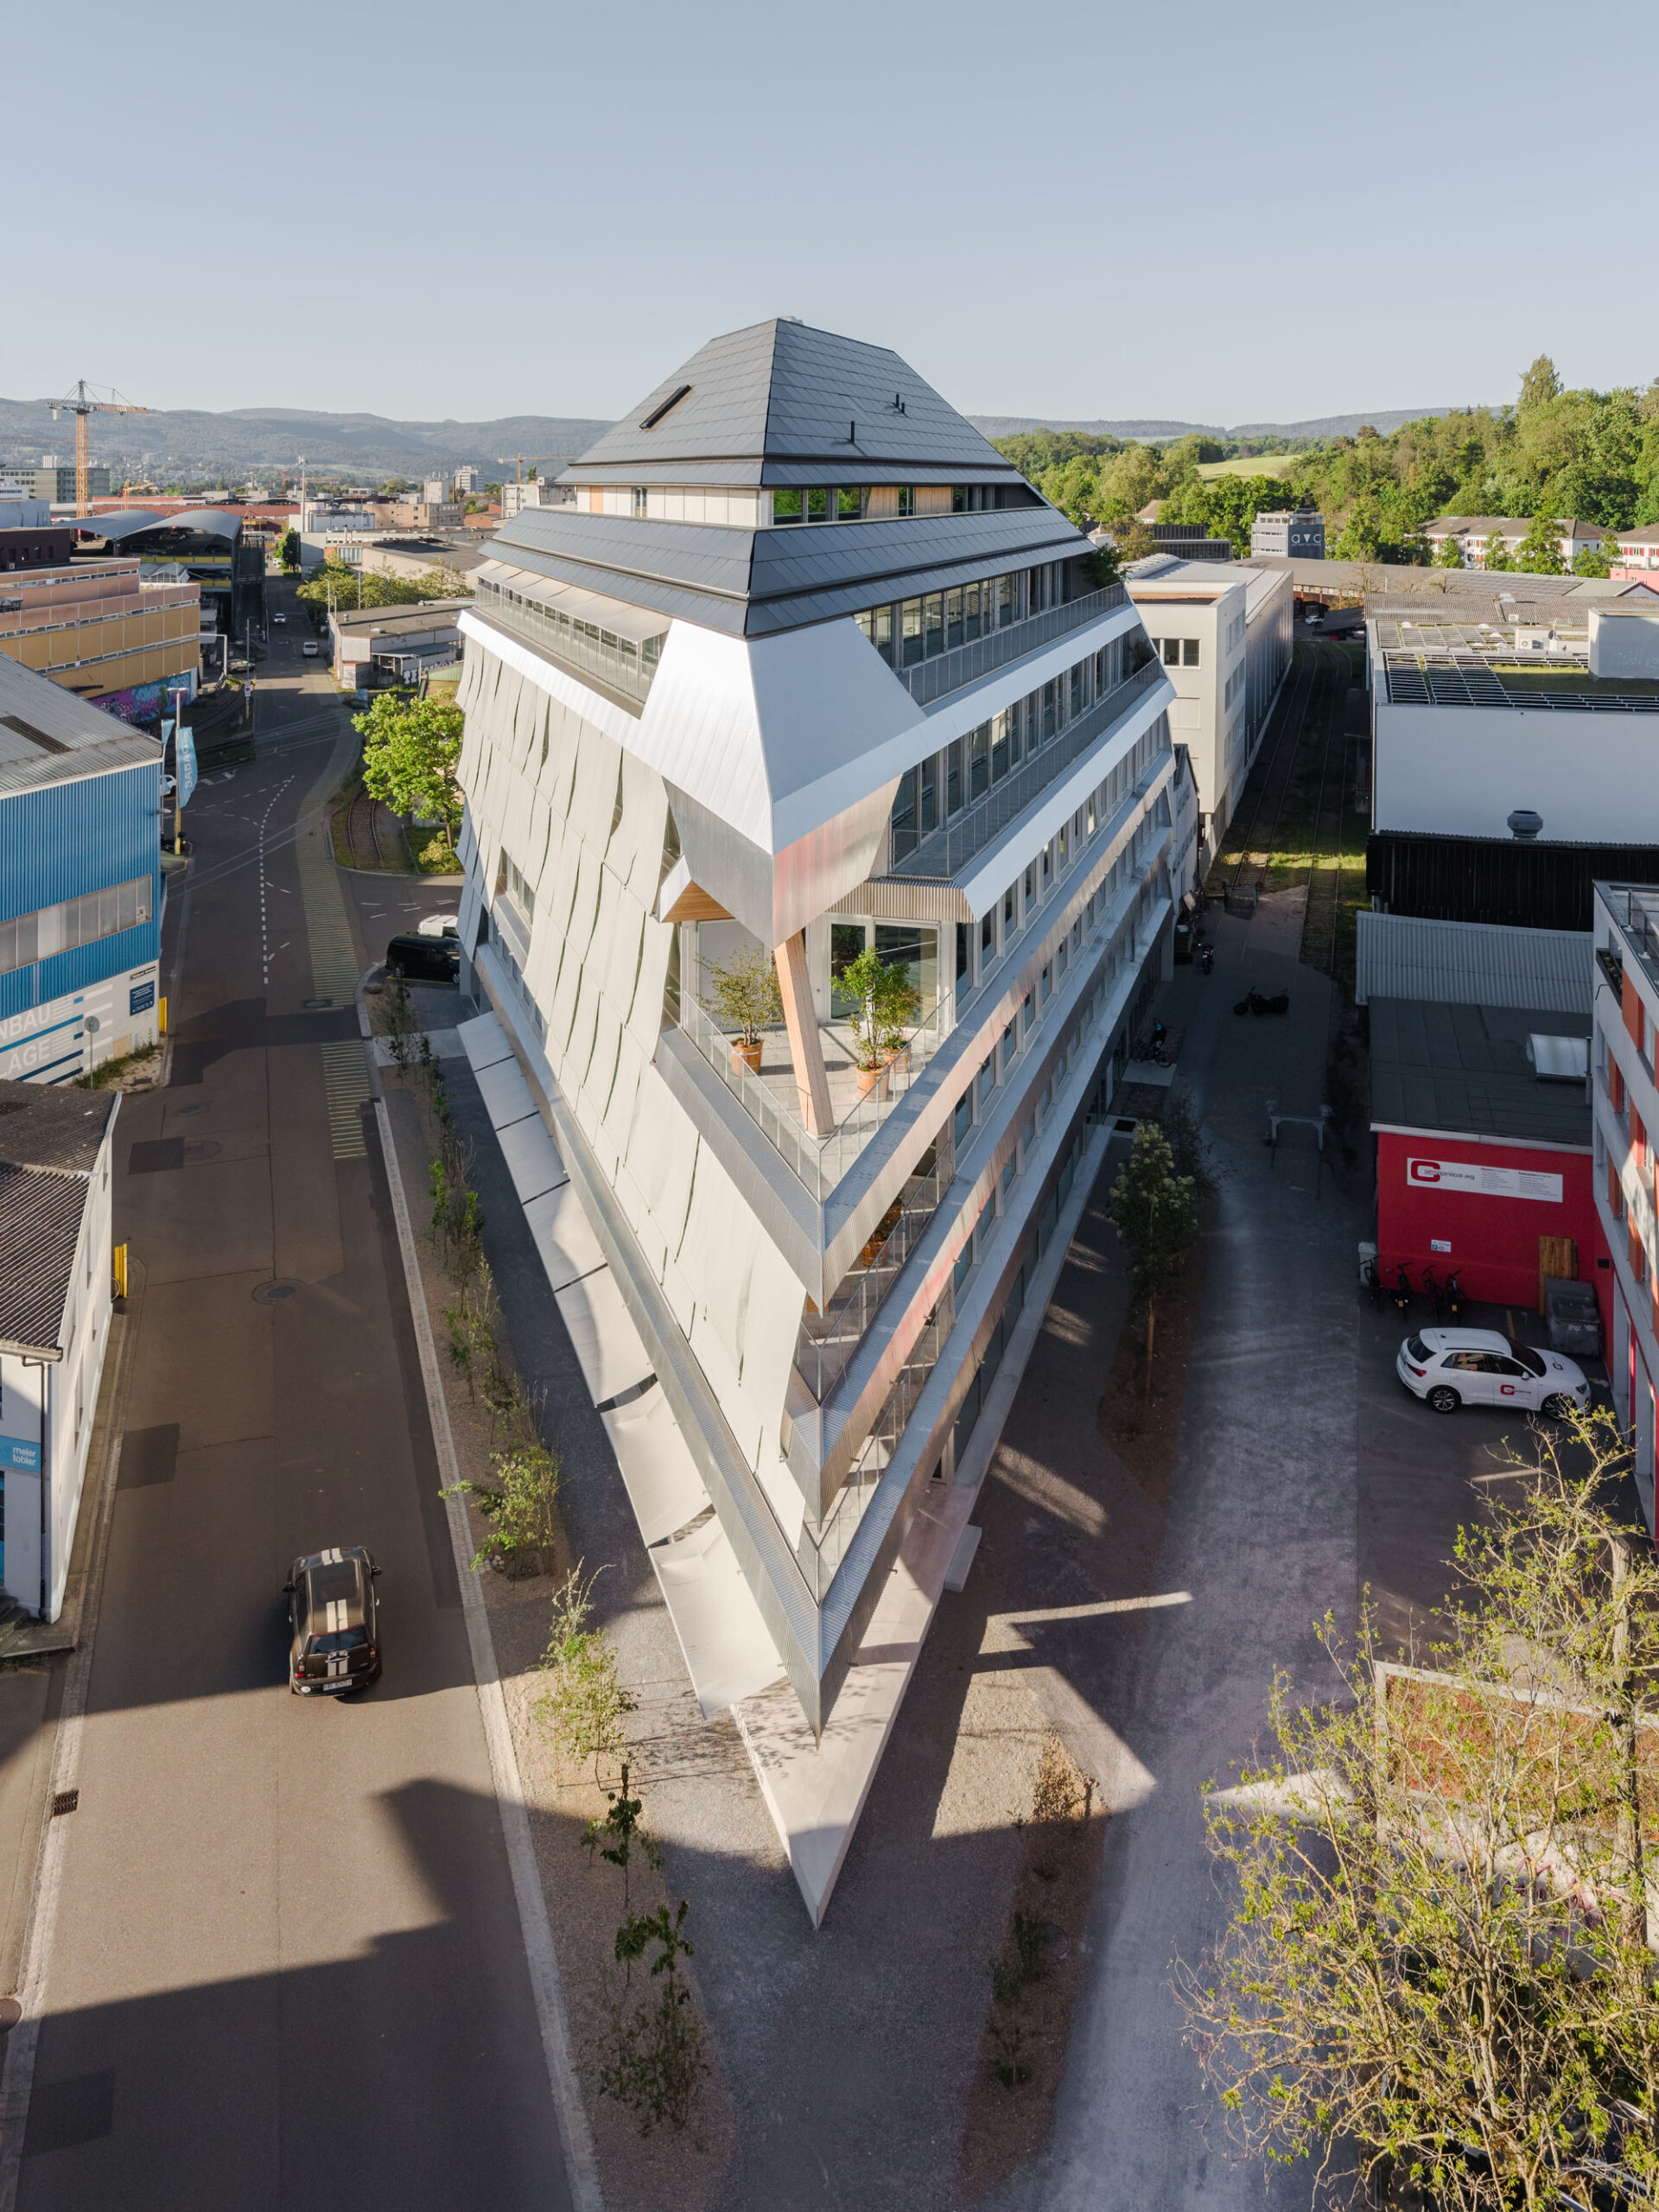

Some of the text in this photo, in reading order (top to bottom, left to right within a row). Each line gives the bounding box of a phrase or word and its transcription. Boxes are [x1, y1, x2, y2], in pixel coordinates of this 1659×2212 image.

[181, 745, 192, 788] SABAG
[13, 1447, 36, 1457] meier
[13, 1454, 36, 1465] tobler
